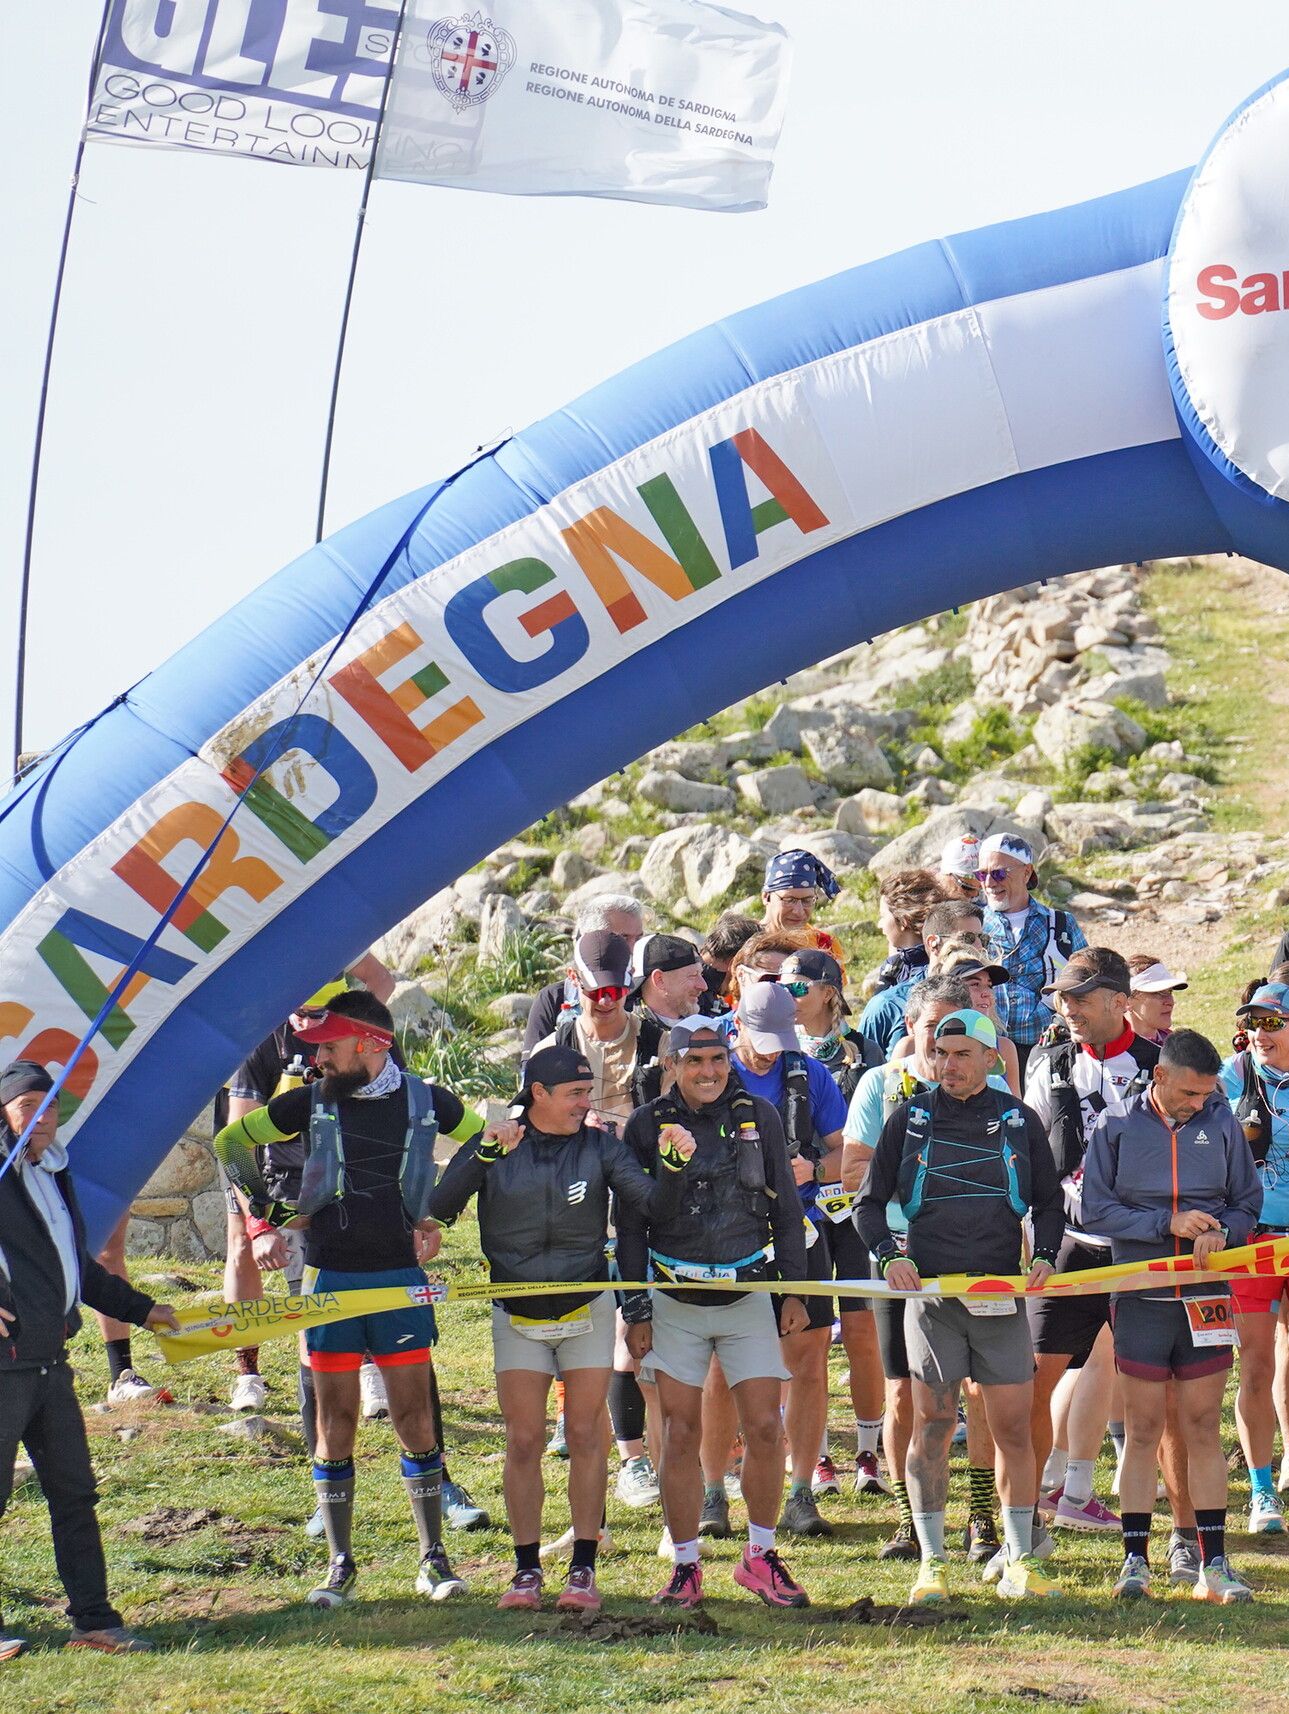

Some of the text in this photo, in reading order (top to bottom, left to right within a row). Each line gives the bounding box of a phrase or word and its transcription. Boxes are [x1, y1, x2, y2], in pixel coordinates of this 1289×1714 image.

[104, 74, 247, 122] GOOD
[525, 81, 754, 146] REGIONE AUTONOMA DELLA SARDEGNA
[529, 62, 589, 84] REGIONE
[658, 94, 676, 108] DE
[677, 98, 737, 123] SARDIGNA
[208, 1292, 341, 1319] SARDEGNA
